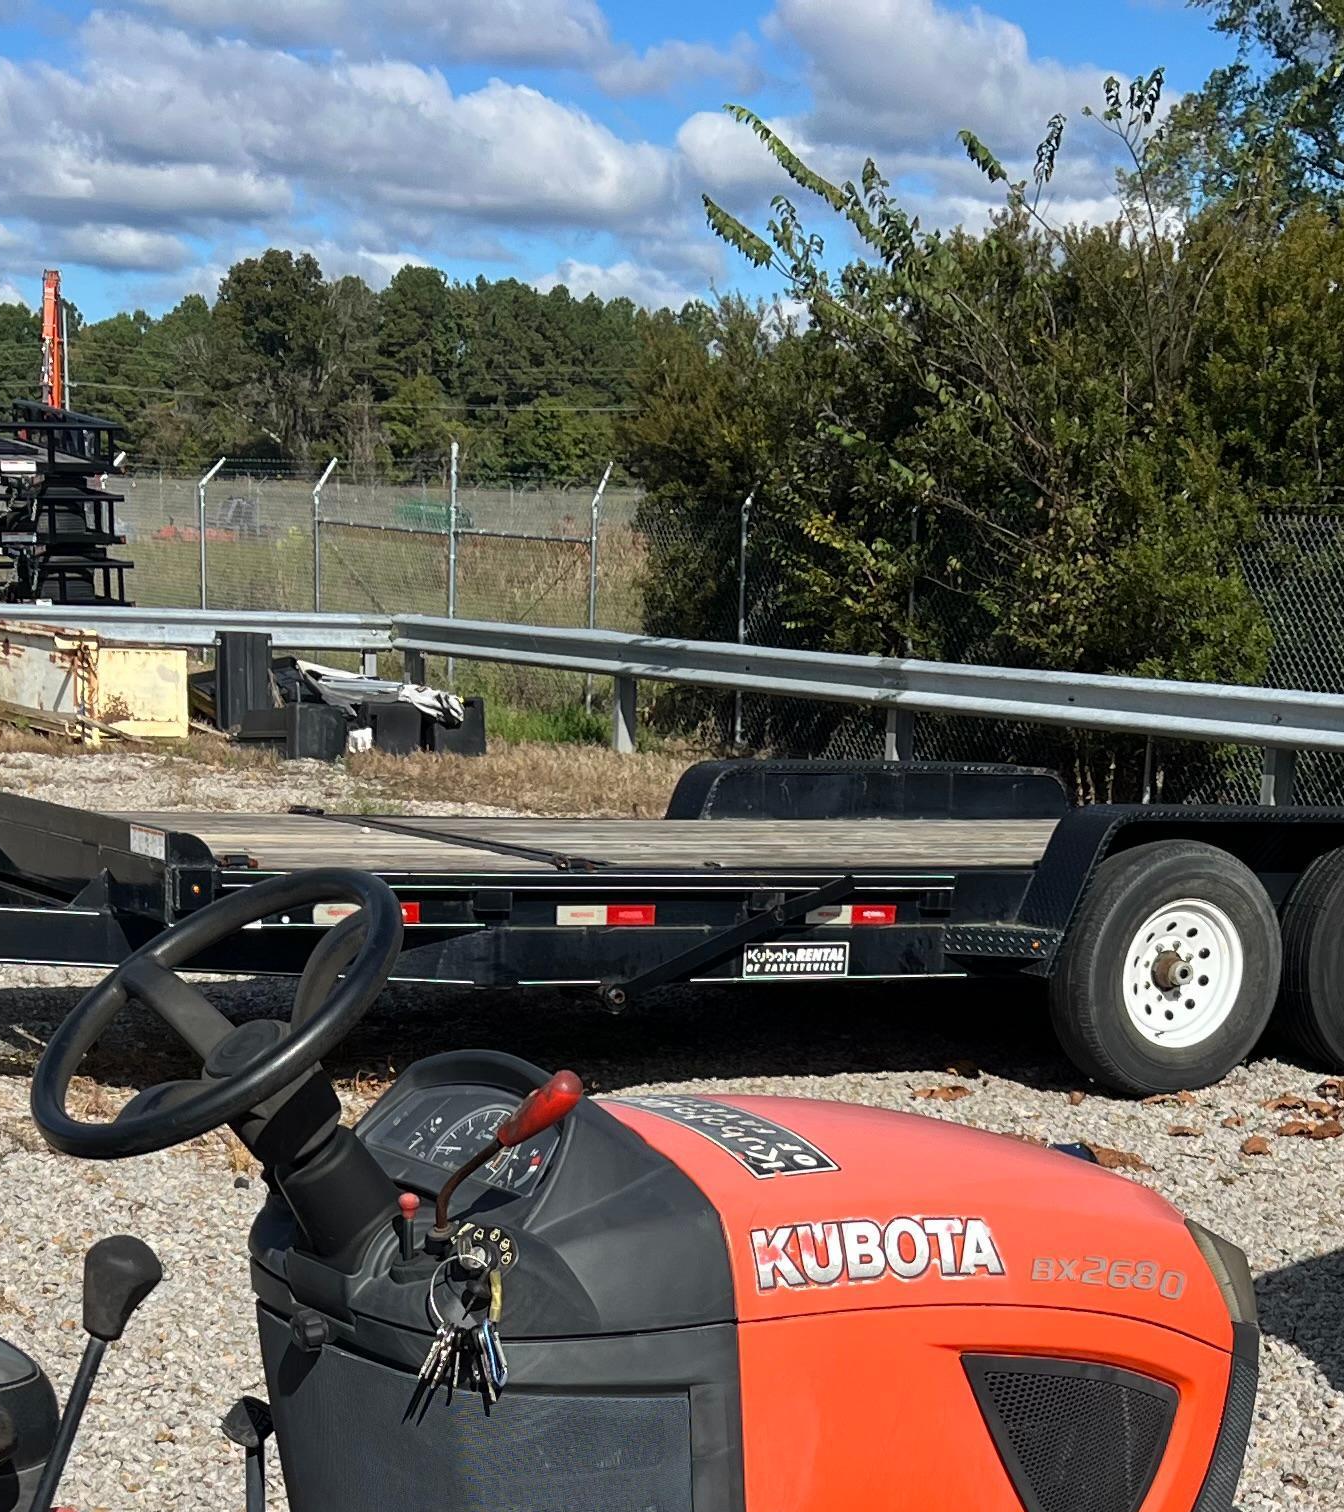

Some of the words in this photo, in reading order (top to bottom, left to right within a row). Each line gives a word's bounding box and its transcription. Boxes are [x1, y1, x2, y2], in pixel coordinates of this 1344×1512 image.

[795, 949, 845, 962] RENTAL
[746, 964, 759, 973] OF
[764, 963, 844, 972] FAYETTEVILLE
[750, 1216, 1006, 1292] KUBOTA
[1030, 1257, 1186, 1300] BX2680
